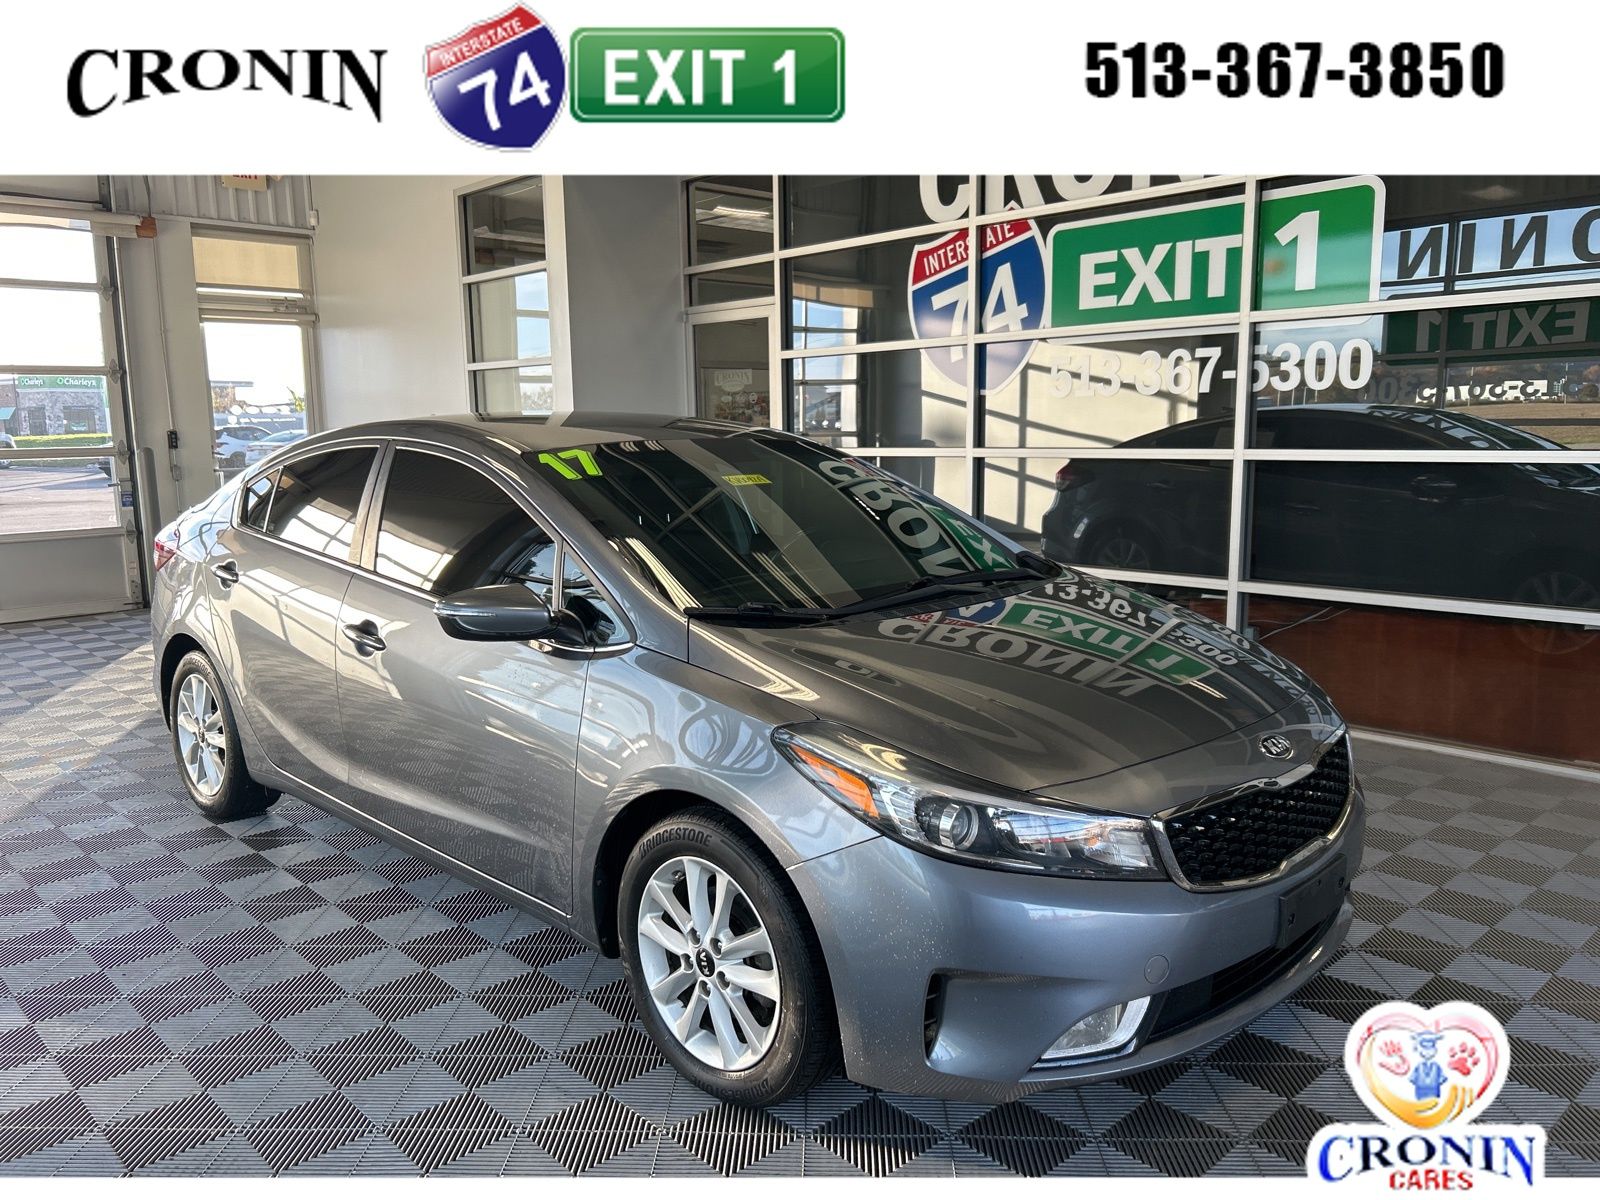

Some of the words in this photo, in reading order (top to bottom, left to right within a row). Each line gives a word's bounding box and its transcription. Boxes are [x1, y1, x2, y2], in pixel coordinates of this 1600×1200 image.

[1078, 233, 1242, 310] EXIT
[1273, 210, 1320, 291] 1
[930, 262, 1029, 363] 74
[539, 449, 603, 480] 17
[639, 827, 712, 859] BRIDGESTONE
